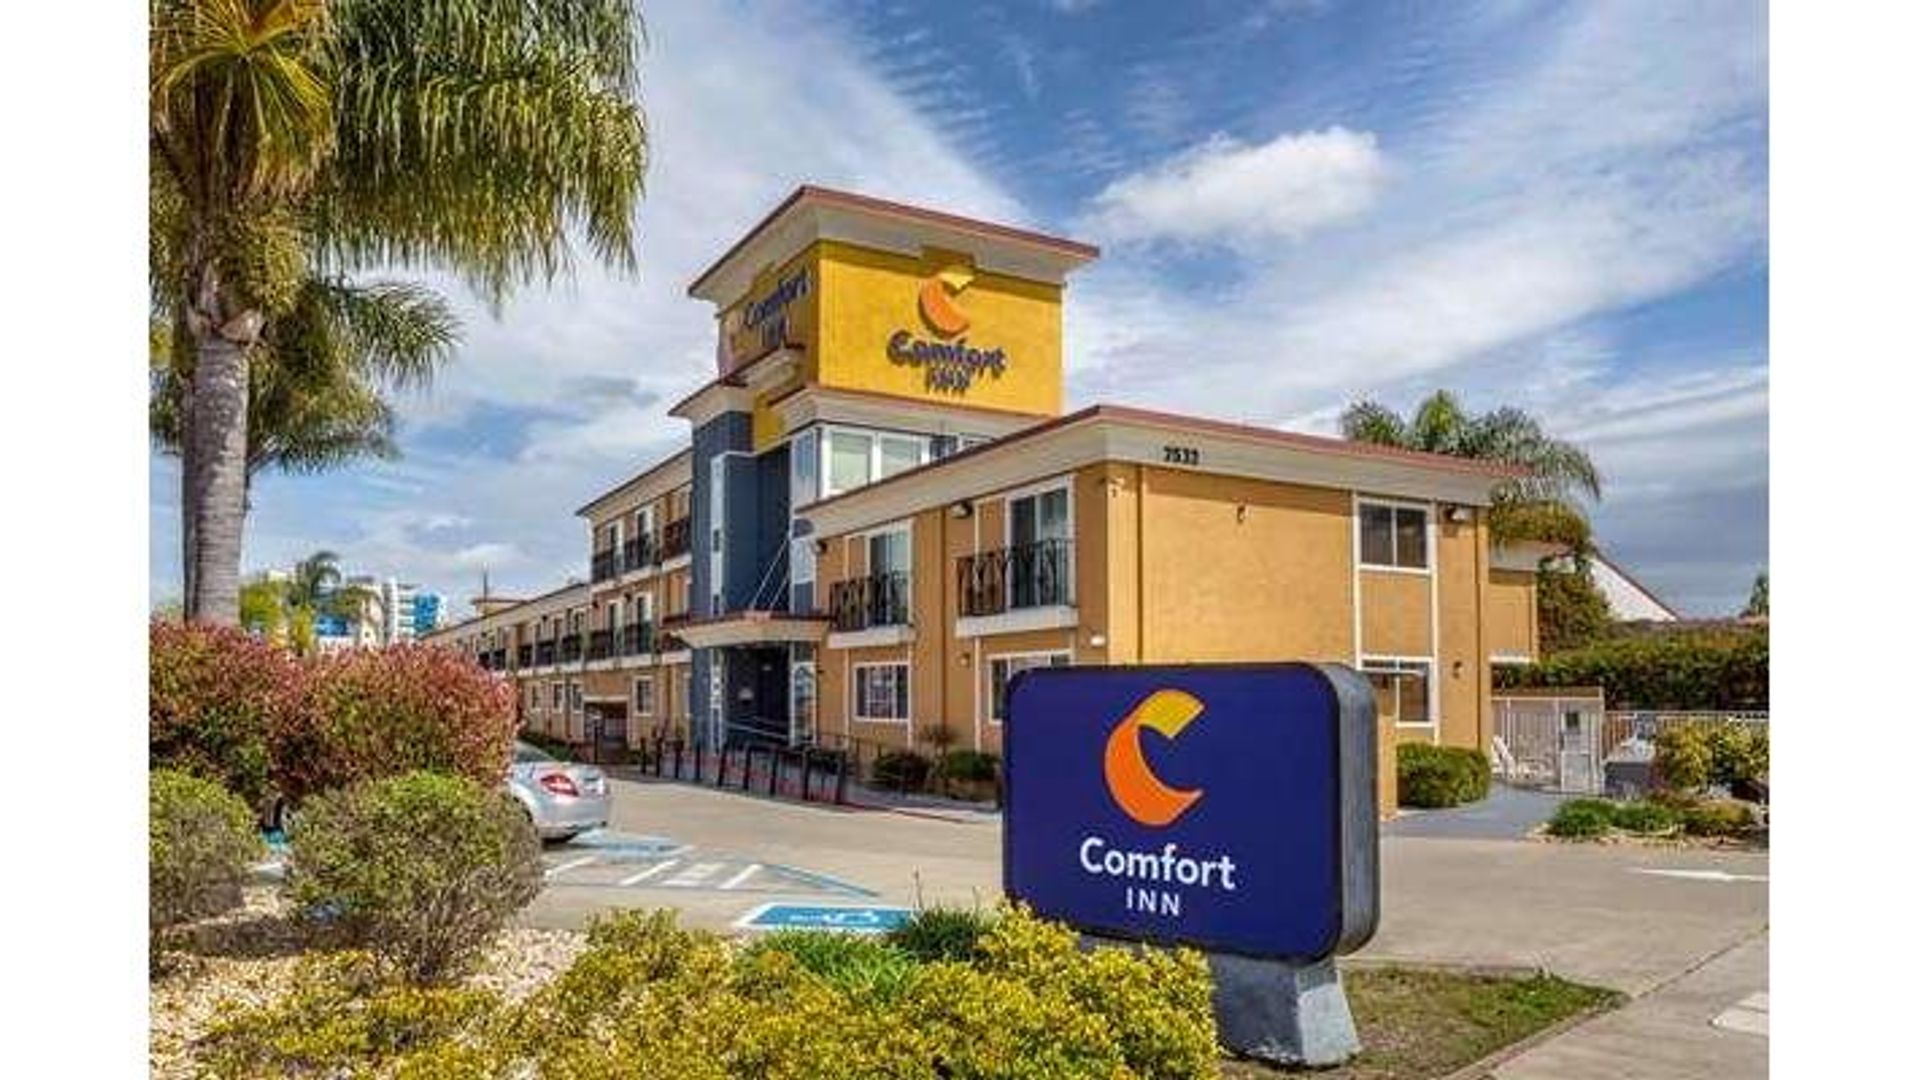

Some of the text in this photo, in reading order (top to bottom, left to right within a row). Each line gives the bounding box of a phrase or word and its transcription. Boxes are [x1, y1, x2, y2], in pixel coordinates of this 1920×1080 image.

[886, 330, 1007, 378] Comfort
[925, 367, 971, 395] INN
[1080, 837, 1235, 889] Comfort
[1126, 887, 1181, 916] INN
